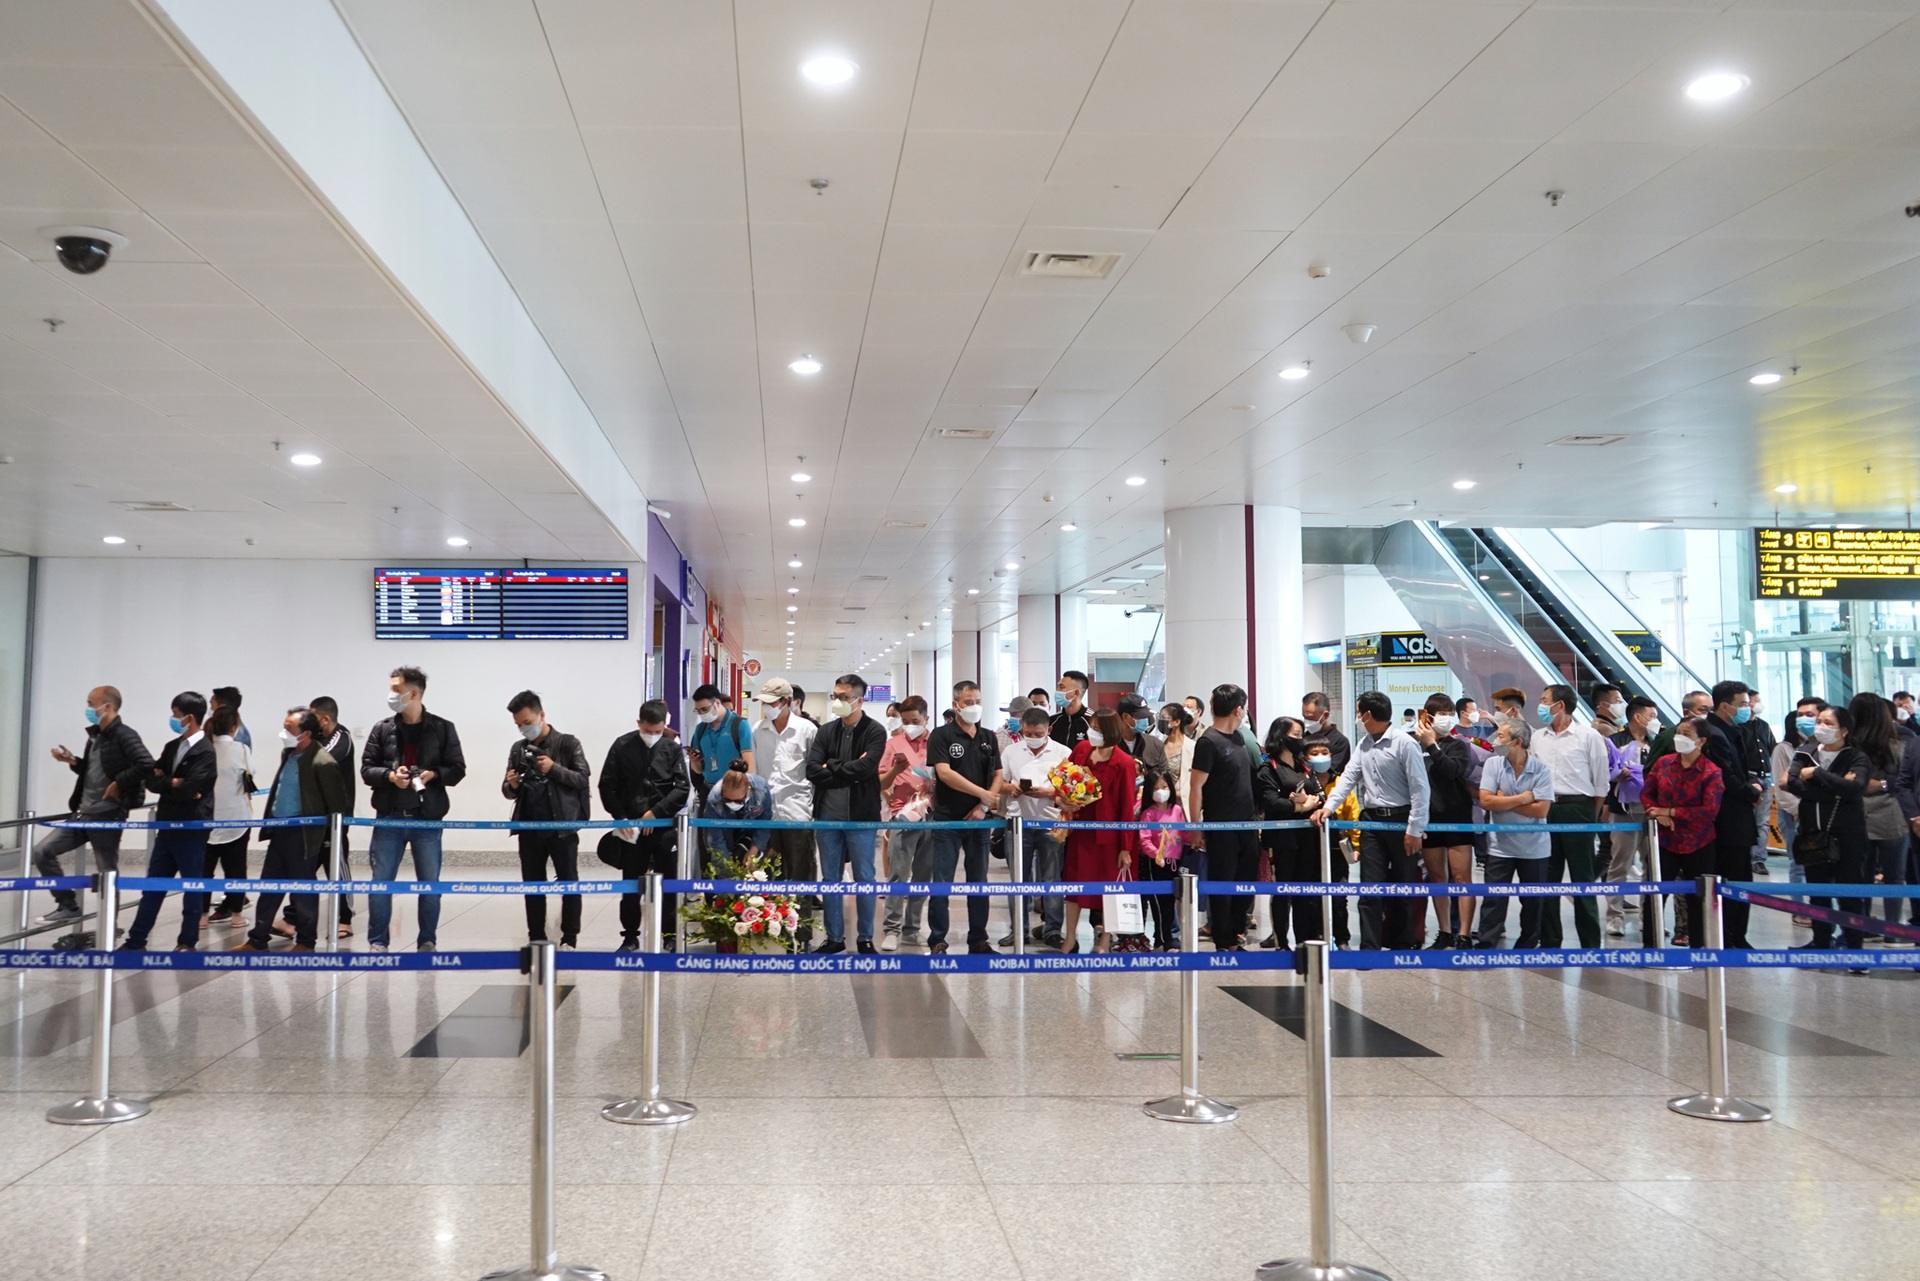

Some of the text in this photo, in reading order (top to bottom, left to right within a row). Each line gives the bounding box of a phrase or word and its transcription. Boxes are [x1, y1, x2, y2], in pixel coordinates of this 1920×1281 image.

[1783, 533, 1793, 547] 3
[1784, 556, 1795, 570] 2
[1786, 580, 1795, 595] 1
[1388, 683, 1445, 694] Money Exchange
[225, 881, 251, 890] CẢNG
[280, 882, 312, 891] KHÔNG
[313, 882, 339, 891] QUỐC
[341, 882, 353, 890] TẾ
[354, 883, 370, 892] NỘI
[451, 882, 477, 892] CẢNG
[506, 882, 537, 892] KHÔNG
[539, 881, 565, 892] QUỐC
[566, 880, 578, 890] TẾ
[581, 882, 596, 893] NỘI
[735, 882, 891, 894] CẢNG HÀNG KHÔNG QUỐC TẾ NỘI BÀI
[951, 885, 1084, 893] NOIBAI INTERNATIONAL AIRPORT
[1277, 883, 1429, 896] CẢNG HÀNG KHÔNG QUỐC TẾ NỘI BÀI
[1448, 886, 1468, 894] N.I.A
[1519, 886, 1582, 894] INTERNATIONAL
[10, 952, 47, 966] QUỐC
[50, 952, 66, 966] TẾ
[66, 954, 89, 968] NỘI
[143, 956, 172, 966] N.I.A
[204, 956, 401, 967] NOIBAI INTERNATIONAL AIRPORT
[432, 956, 462, 966] N.I.A
[616, 957, 644, 968] N.I.A
[989, 956, 1180, 969] NOIBAI INTERNATIONAL AIRPORT
[1210, 956, 1238, 967] N.I.A
[1394, 955, 1422, 965] N.I.A
[1452, 951, 1665, 965] CẢNG HÀNG KHÔNG QUỐC TẾ NỘI BÀI
[1690, 952, 1718, 963] N.I.A
[1747, 953, 1786, 964] NOIBAI
[1789, 953, 1876, 964] INTERNATIONAL
[676, 956, 901, 972] CẢNG HÀNG KHÔNG QUỐC TẾ NỘI BÀI
[930, 959, 958, 969] N.I.A
